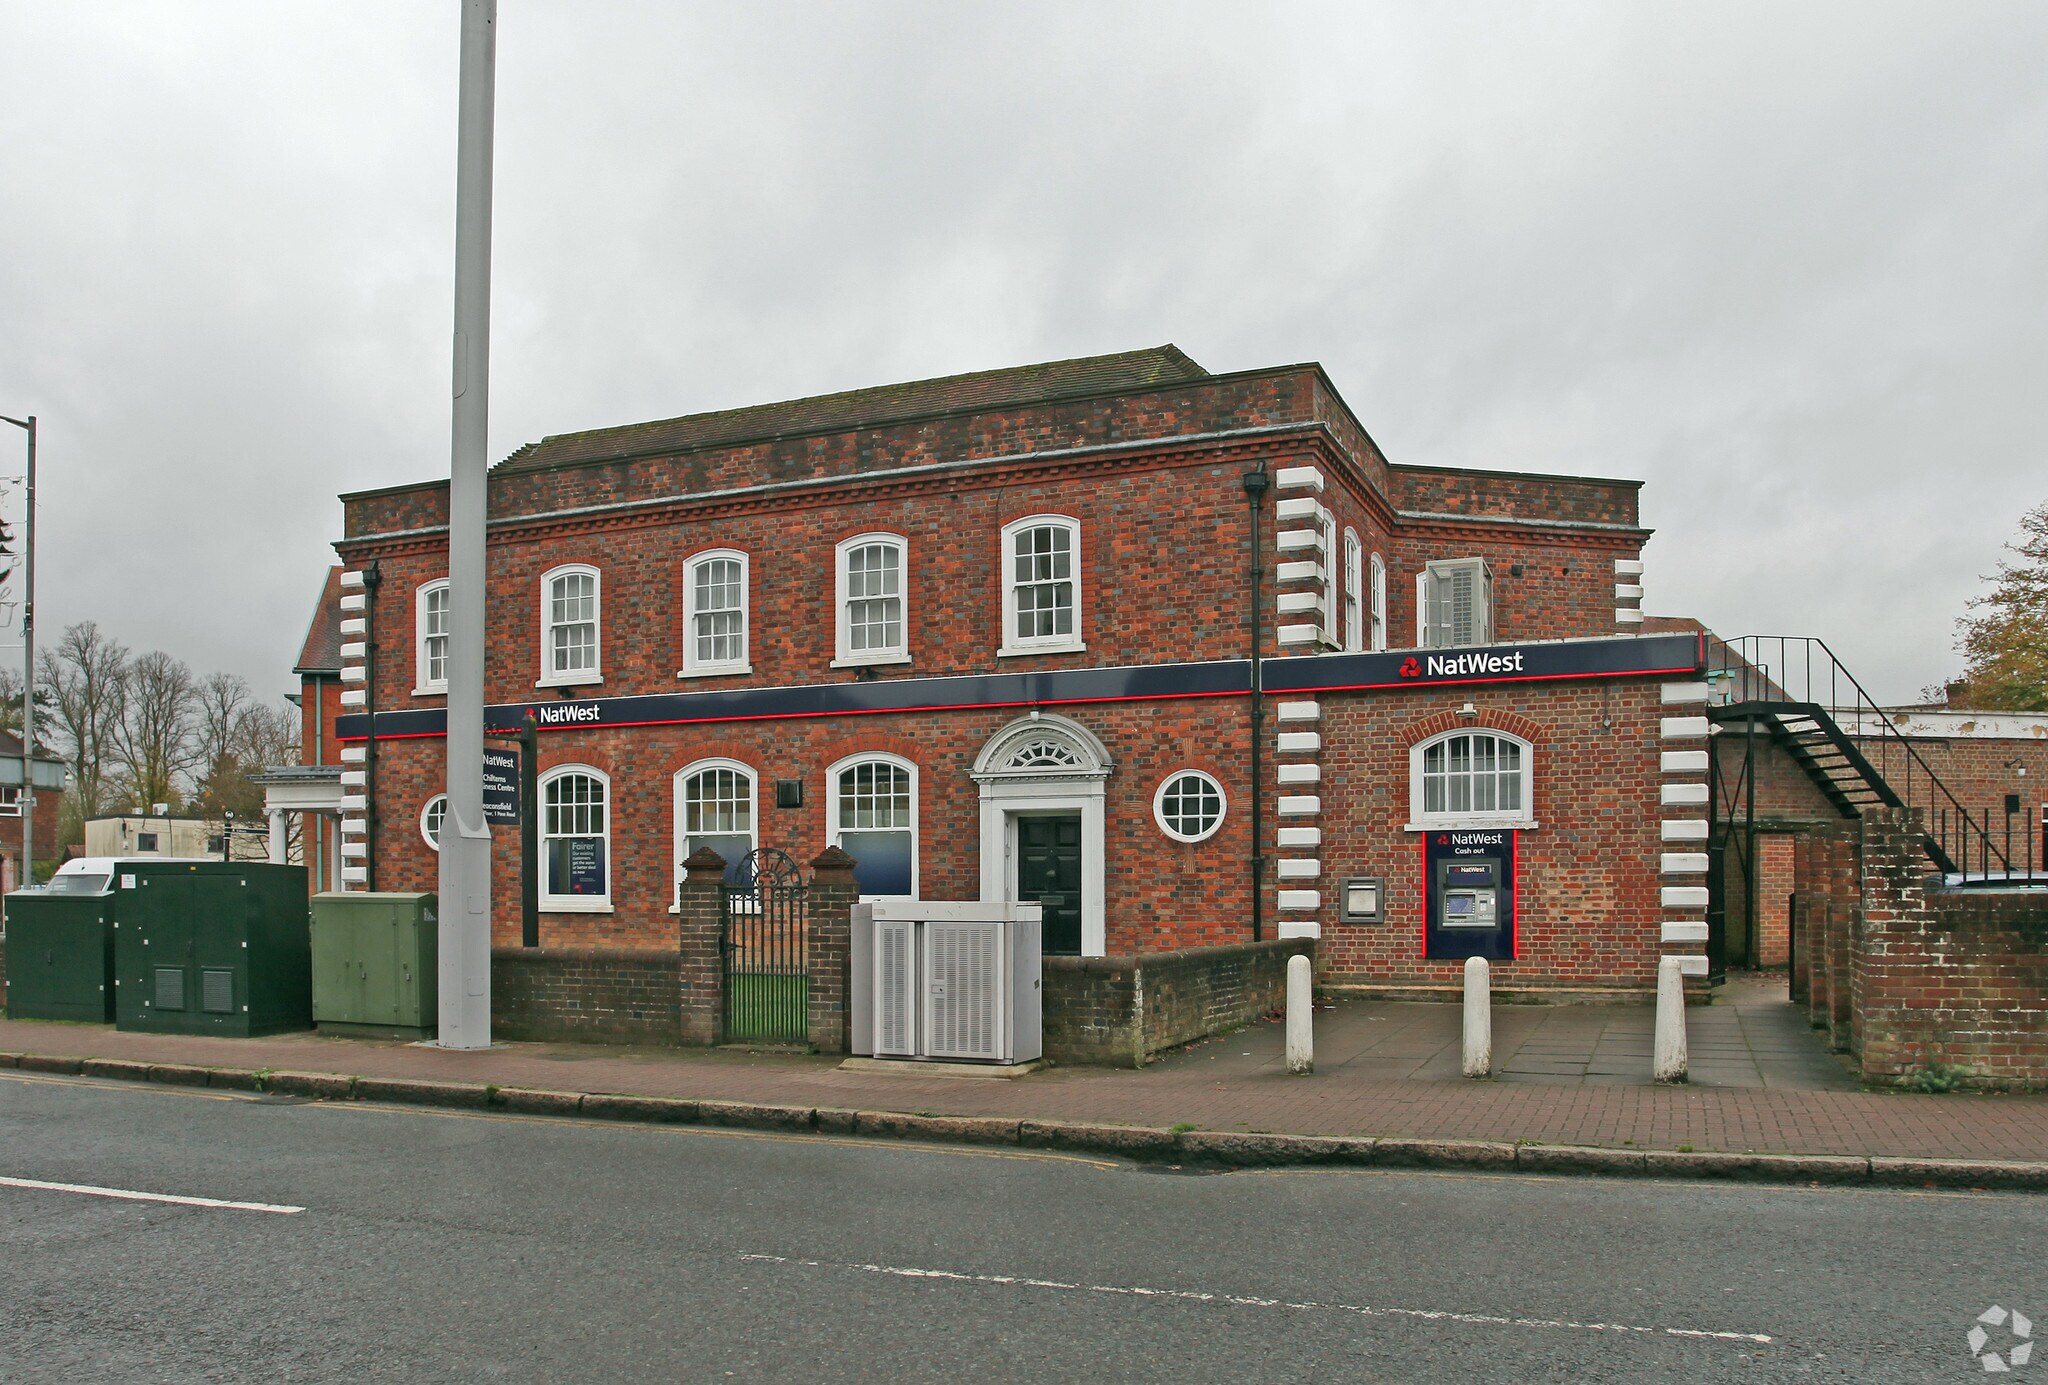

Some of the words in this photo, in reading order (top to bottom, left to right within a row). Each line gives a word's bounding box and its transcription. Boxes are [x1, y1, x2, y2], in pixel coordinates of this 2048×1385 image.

[1427, 651, 1524, 676] NatWest
[540, 704, 600, 723] NatWest
[482, 754, 514, 768] NatWest
[483, 783, 497, 791] iness
[497, 783, 515, 792] Centre
[482, 802, 512, 811] eaconsfield
[1452, 833, 1503, 845] NatWest
[572, 842, 595, 850] Fairer
